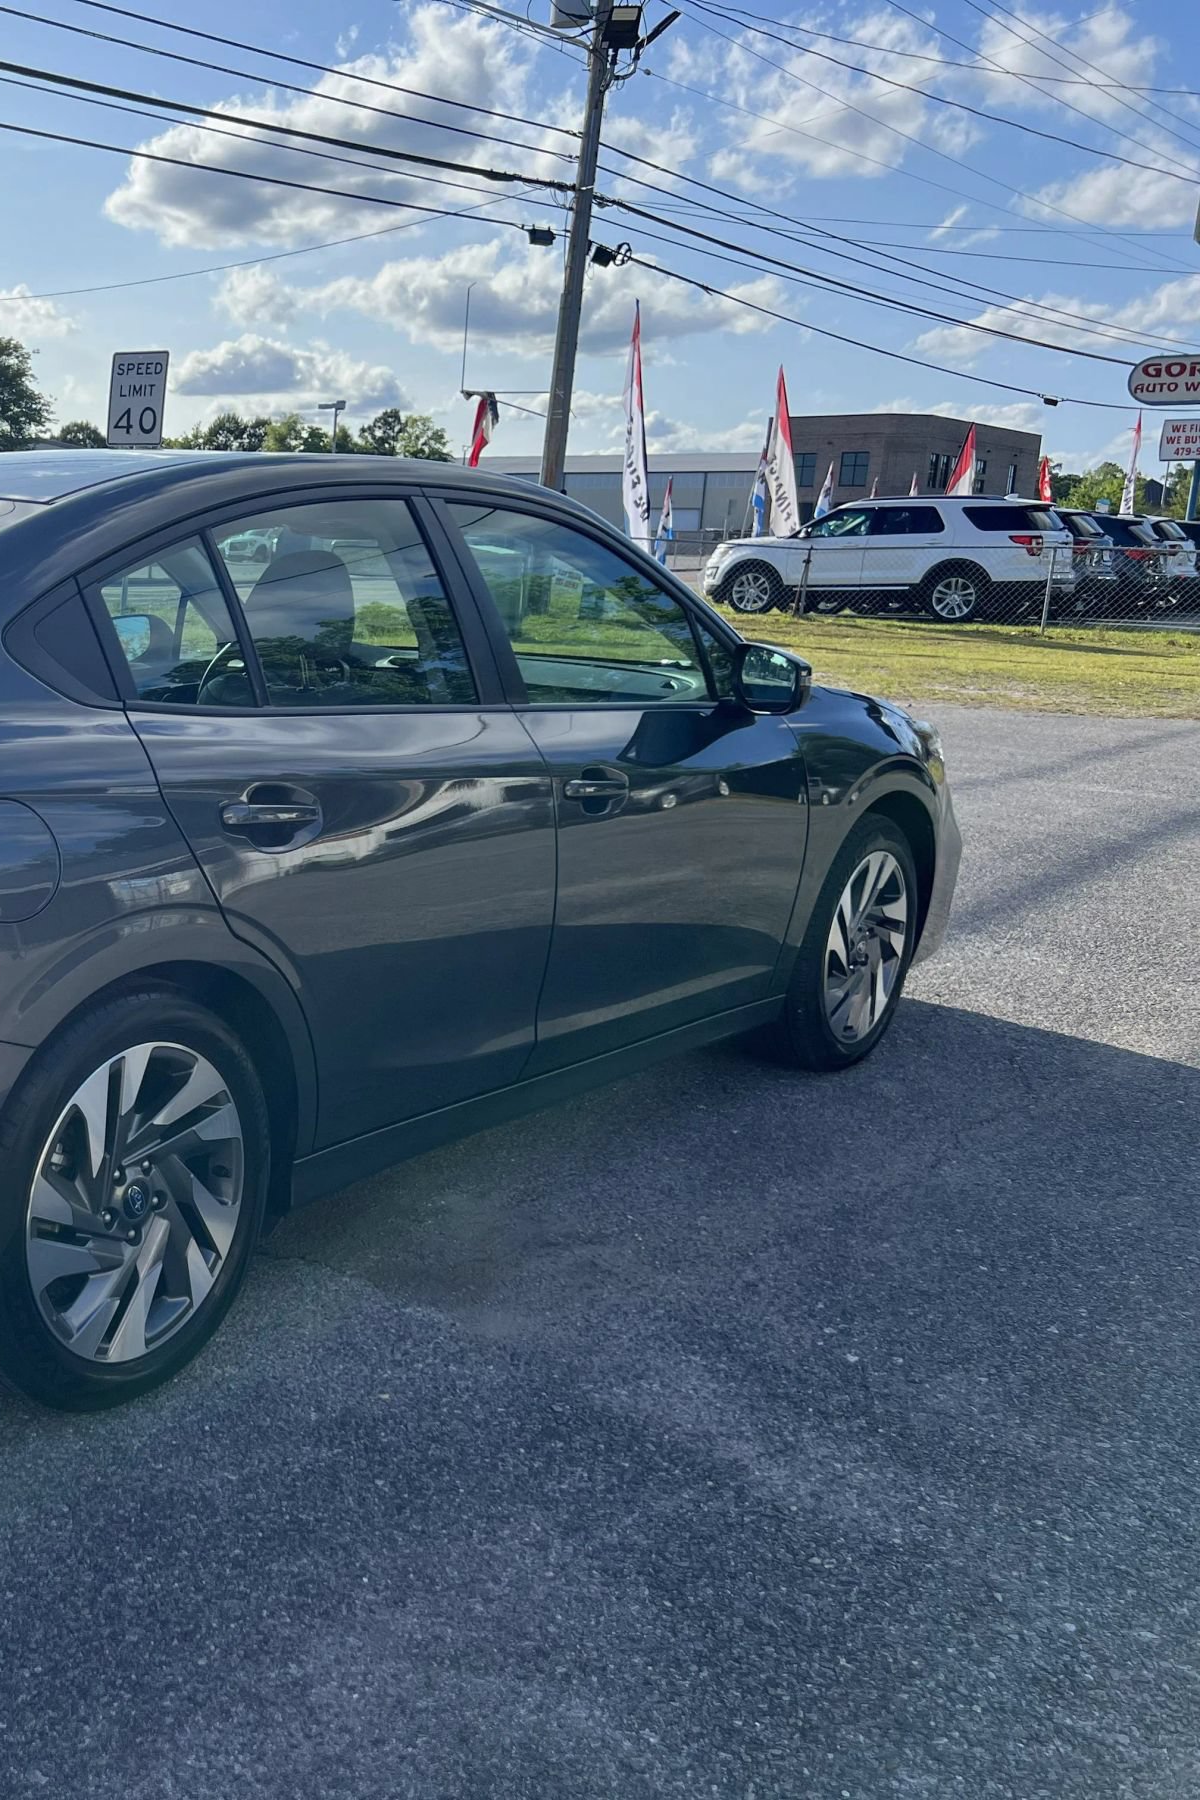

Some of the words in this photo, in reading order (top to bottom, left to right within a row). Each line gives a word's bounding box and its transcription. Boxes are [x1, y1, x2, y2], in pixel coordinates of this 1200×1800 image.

[117, 362, 163, 376] SPEED
[119, 384, 156, 398] LIMIT
[1133, 382, 1179, 394] AUTO
[113, 406, 157, 435] 40
[1171, 424, 1187, 433] WE
[1189, 424, 1200, 433] FI
[1166, 435, 1182, 445] WE
